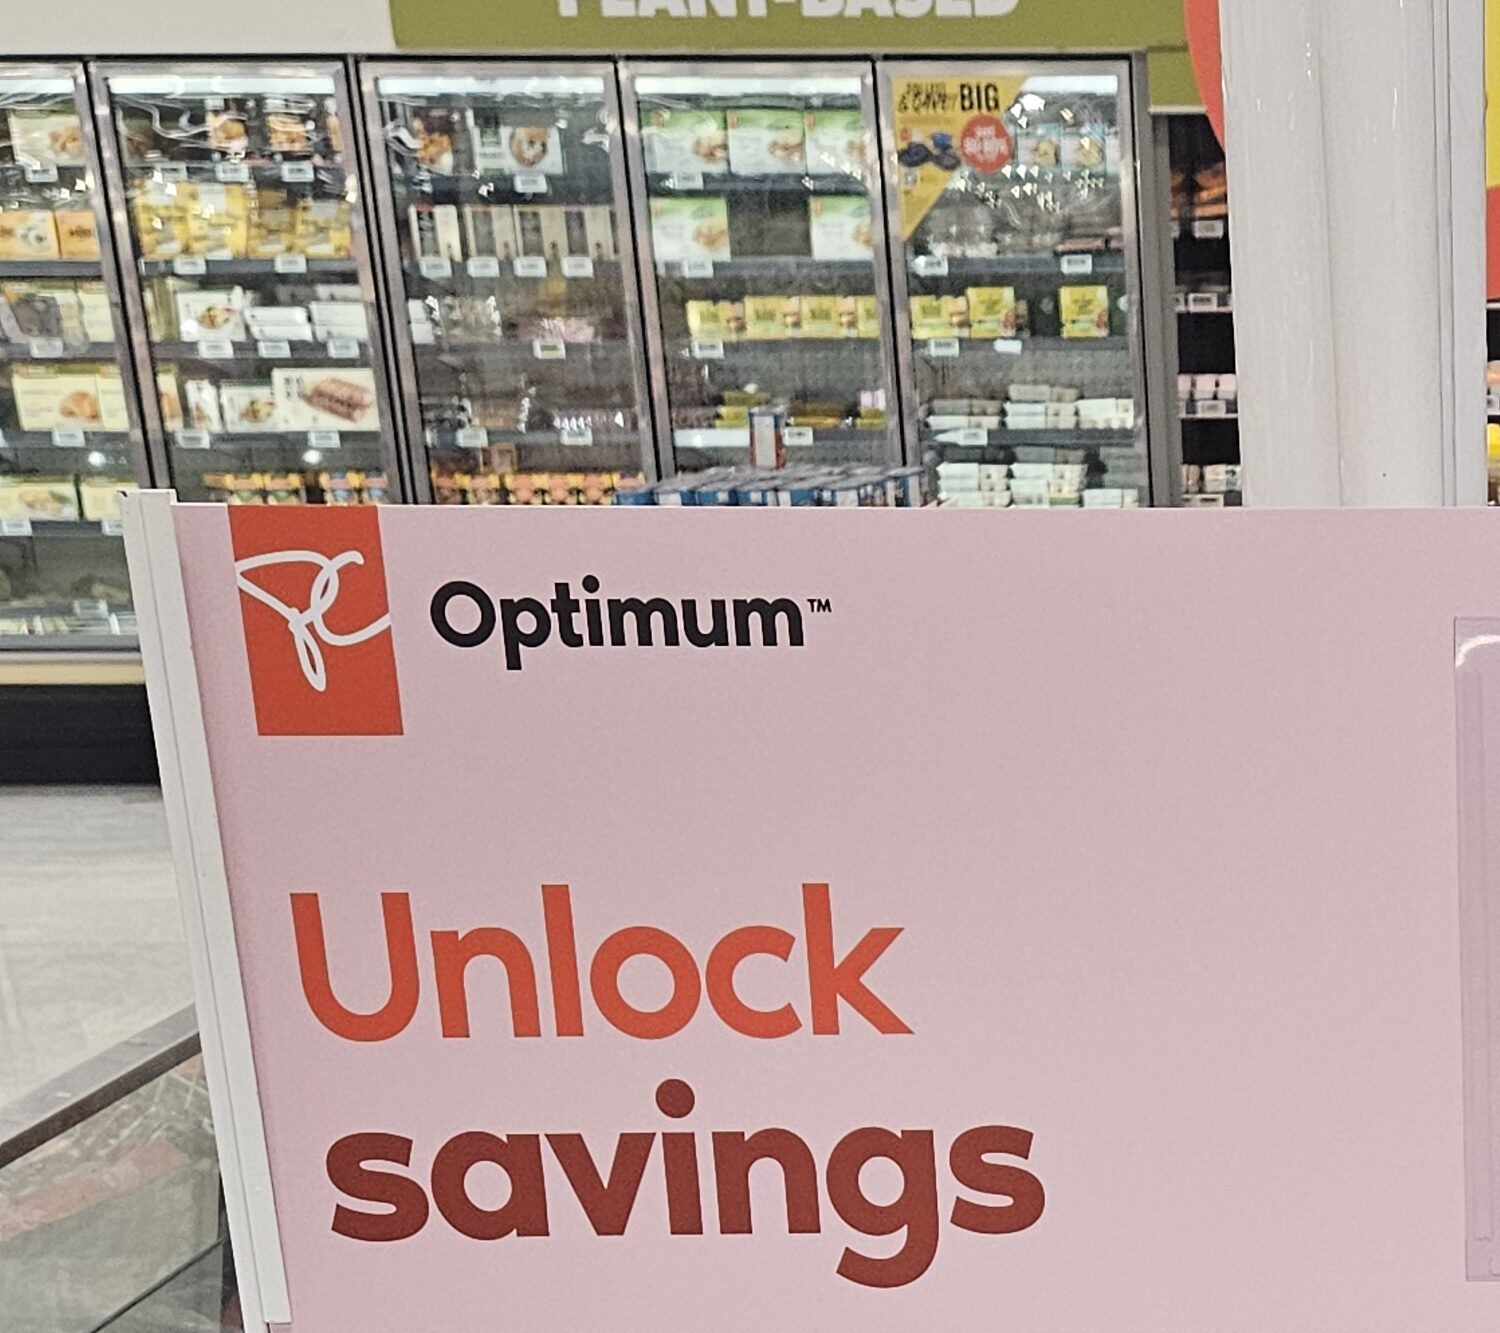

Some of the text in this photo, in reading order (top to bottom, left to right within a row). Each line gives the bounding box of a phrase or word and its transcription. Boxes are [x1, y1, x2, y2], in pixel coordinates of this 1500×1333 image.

[960, 83, 999, 111] BIG
[290, 883, 915, 1041] Unlock
[325, 1078, 1046, 1288] savings
